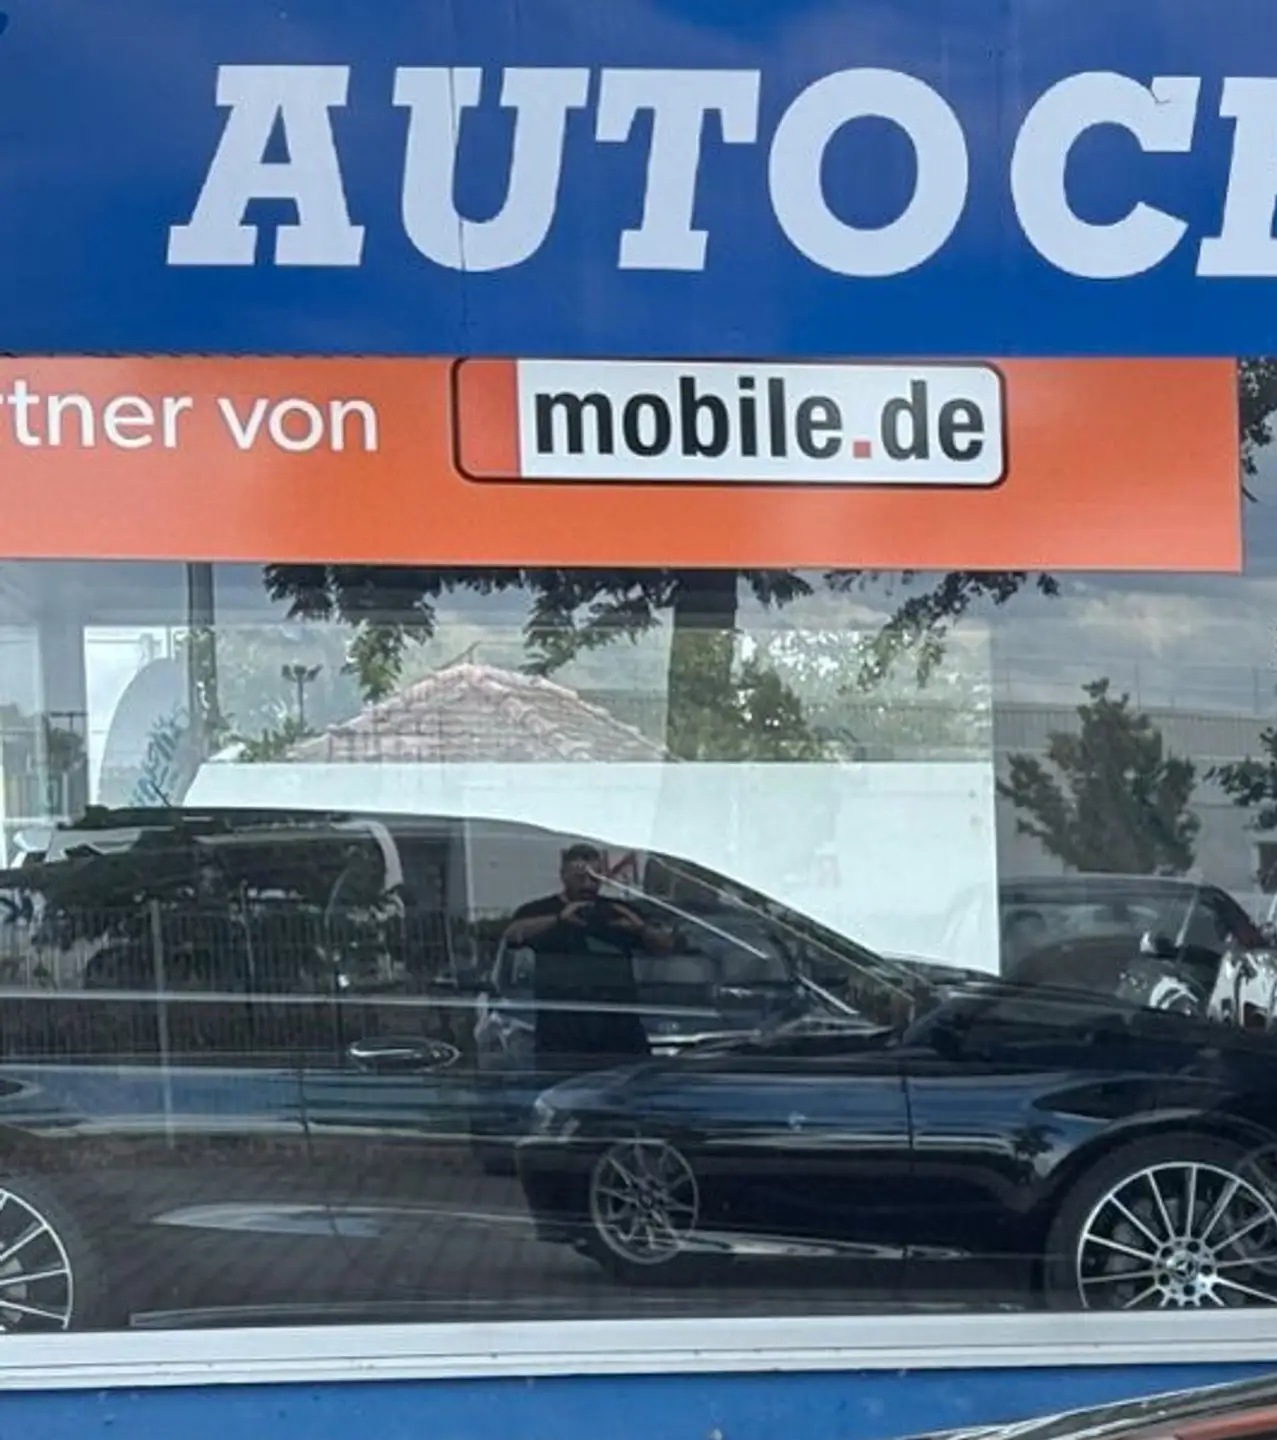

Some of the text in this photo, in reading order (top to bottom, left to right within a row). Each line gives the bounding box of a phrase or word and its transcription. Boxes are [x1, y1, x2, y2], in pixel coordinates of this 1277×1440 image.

[0, 375, 985, 461] tner von mobile.de
